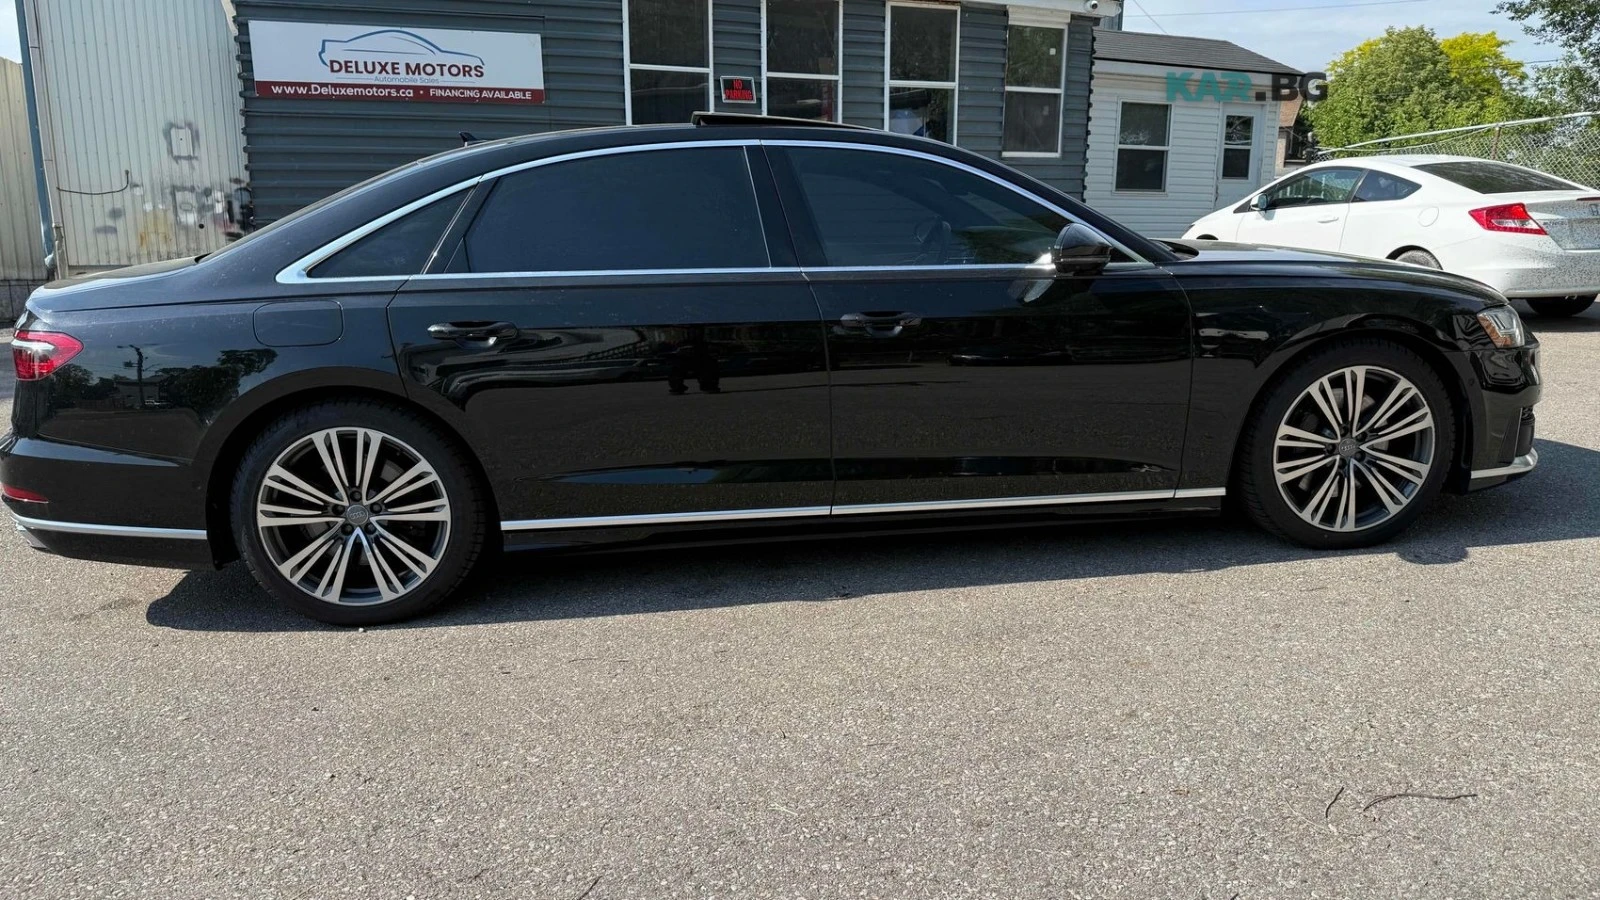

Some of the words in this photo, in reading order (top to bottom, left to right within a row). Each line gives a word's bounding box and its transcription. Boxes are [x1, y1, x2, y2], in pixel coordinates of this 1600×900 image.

[329, 59, 400, 75] DELUXE
[405, 62, 485, 78] MOTORS
[374, 75, 418, 83] Automobile
[733, 79, 743, 90] NO
[271, 84, 414, 97] www.Deluxemotors.ca
[429, 88, 480, 98] FINANCING
[481, 90, 532, 100] AVAILABLE
[725, 89, 753, 99] PARKING
